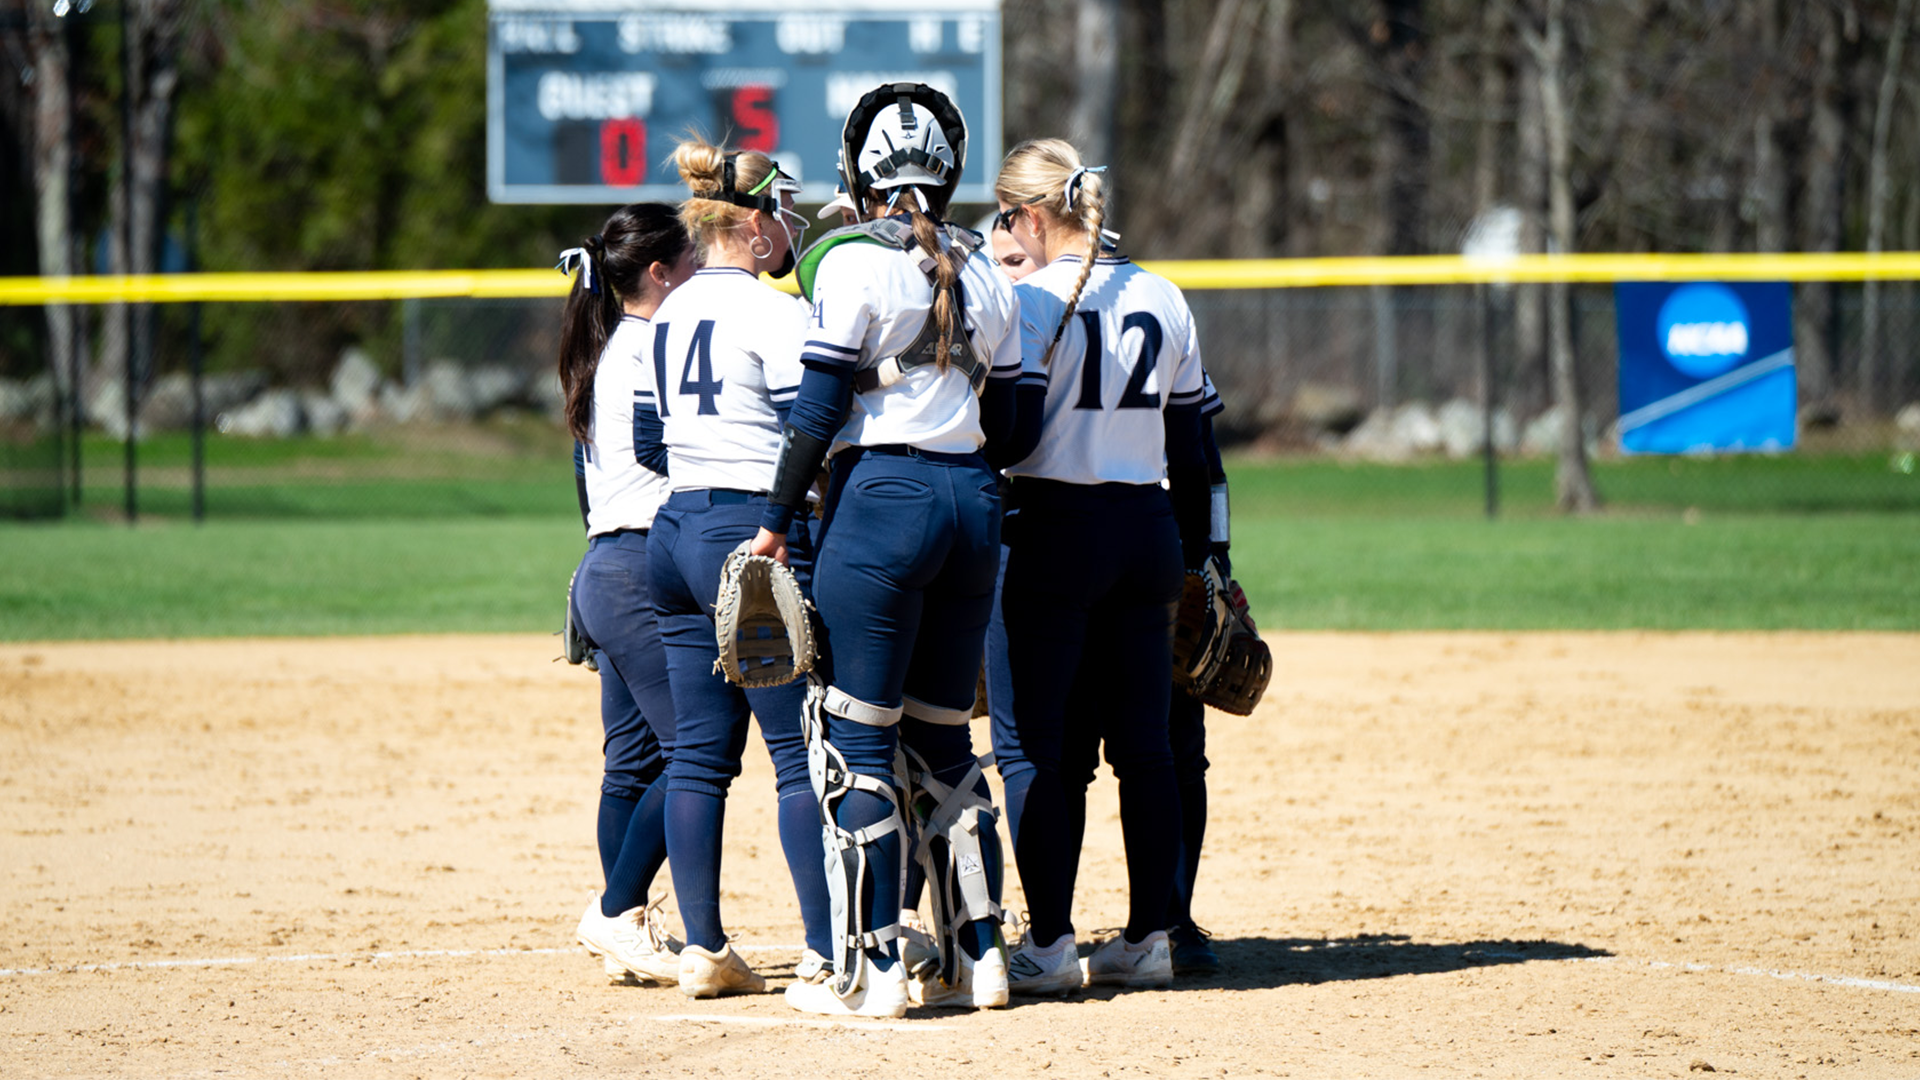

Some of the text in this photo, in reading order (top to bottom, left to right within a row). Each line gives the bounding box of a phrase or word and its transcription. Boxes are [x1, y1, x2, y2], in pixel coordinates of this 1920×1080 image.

[538, 71, 656, 120] GUEST
[733, 84, 779, 153] 5
[601, 117, 646, 187] 0
[653, 319, 725, 417] 14
[1072, 309, 1171, 410] 12
[1667, 322, 1748, 357] NCAA
